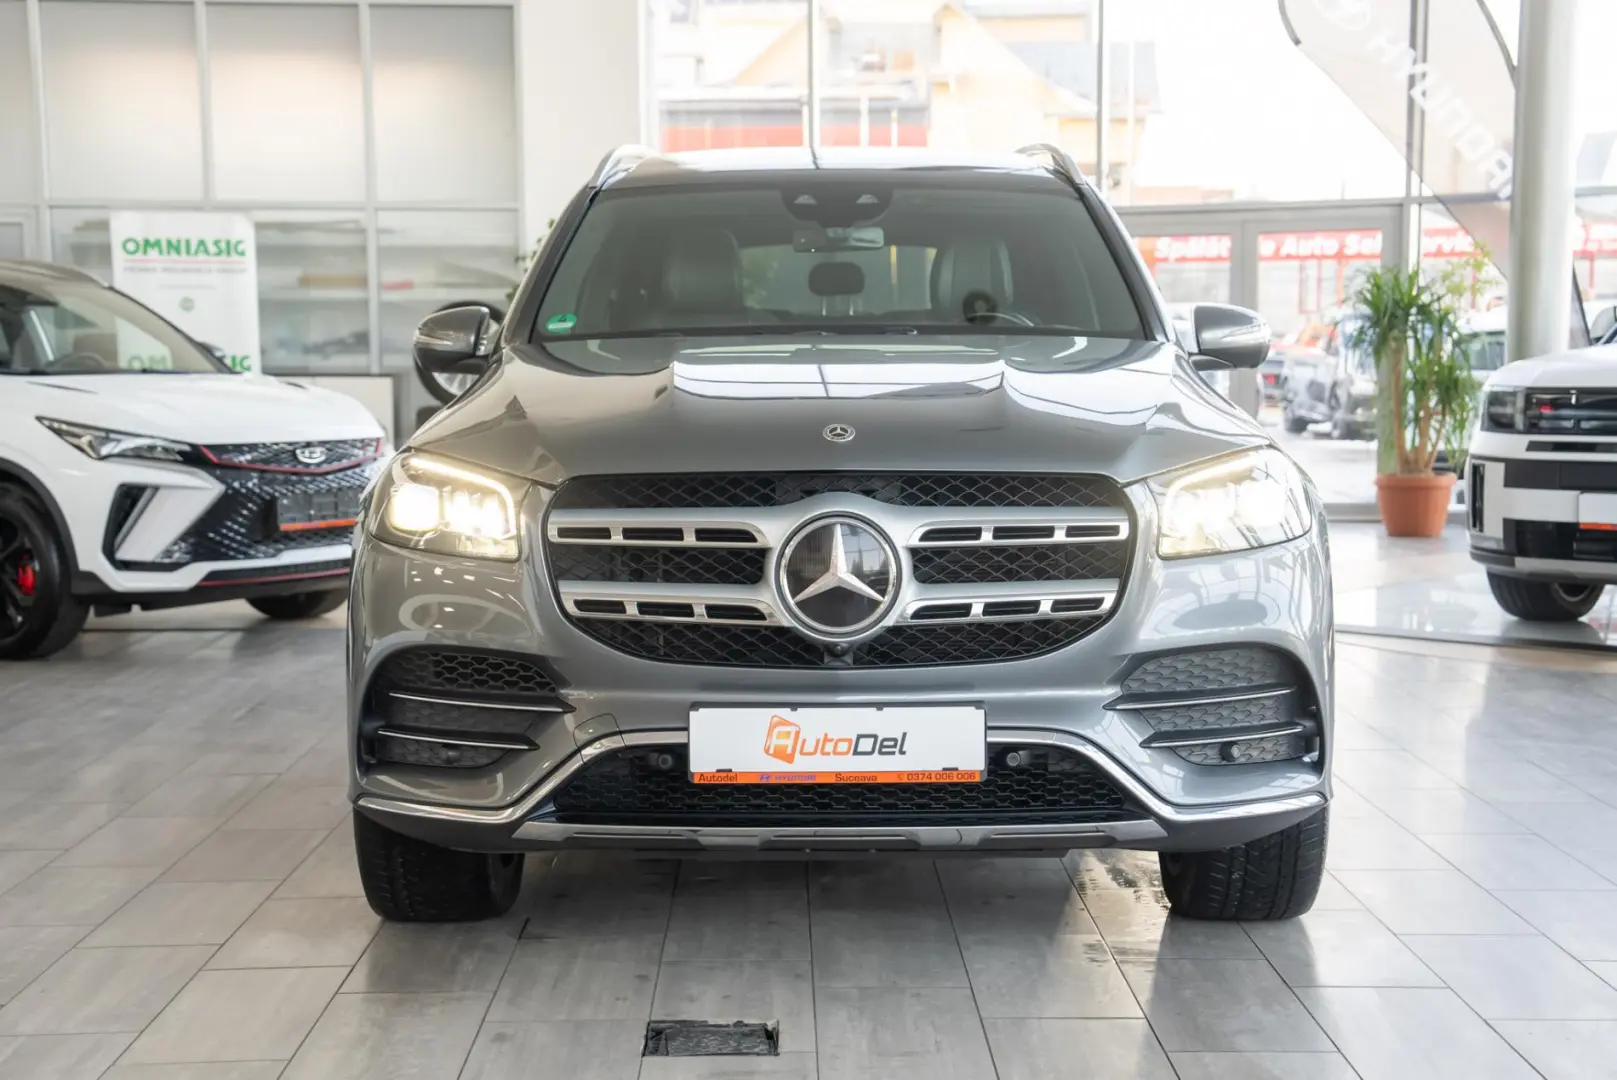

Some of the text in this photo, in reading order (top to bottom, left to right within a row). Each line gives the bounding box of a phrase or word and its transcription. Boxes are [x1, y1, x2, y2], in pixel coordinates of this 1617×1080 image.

[122, 238, 246, 257] OMNIASIG
[1280, 235, 1339, 256] Auto
[766, 721, 907, 759] AutoDel
[698, 773, 738, 783] Autodel
[834, 773, 878, 782] Suceava
[906, 772, 932, 781] 0374
[935, 772, 954, 781] 006
[956, 771, 976, 781] 006
